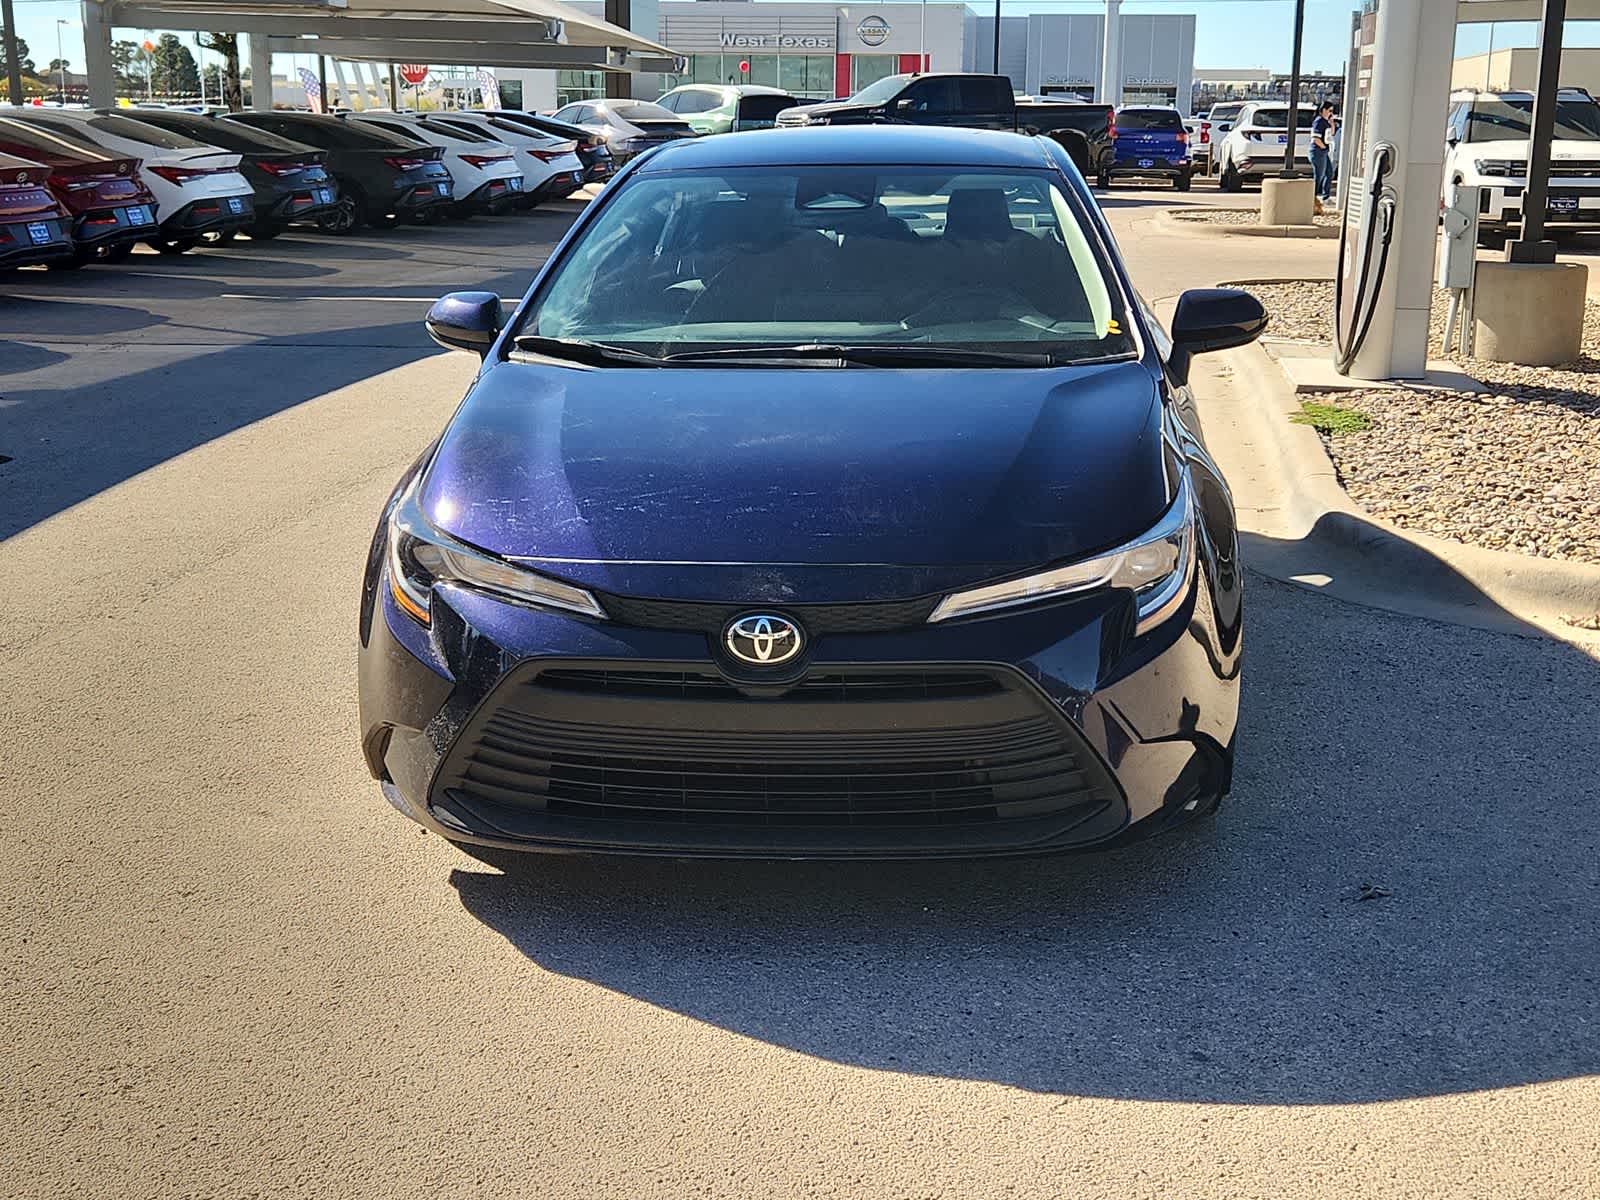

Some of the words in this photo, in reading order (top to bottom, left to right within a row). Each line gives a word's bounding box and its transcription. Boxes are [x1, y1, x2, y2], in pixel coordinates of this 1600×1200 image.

[719, 33, 766, 47] West
[771, 34, 829, 48] Texas
[402, 64, 426, 74] STOP
